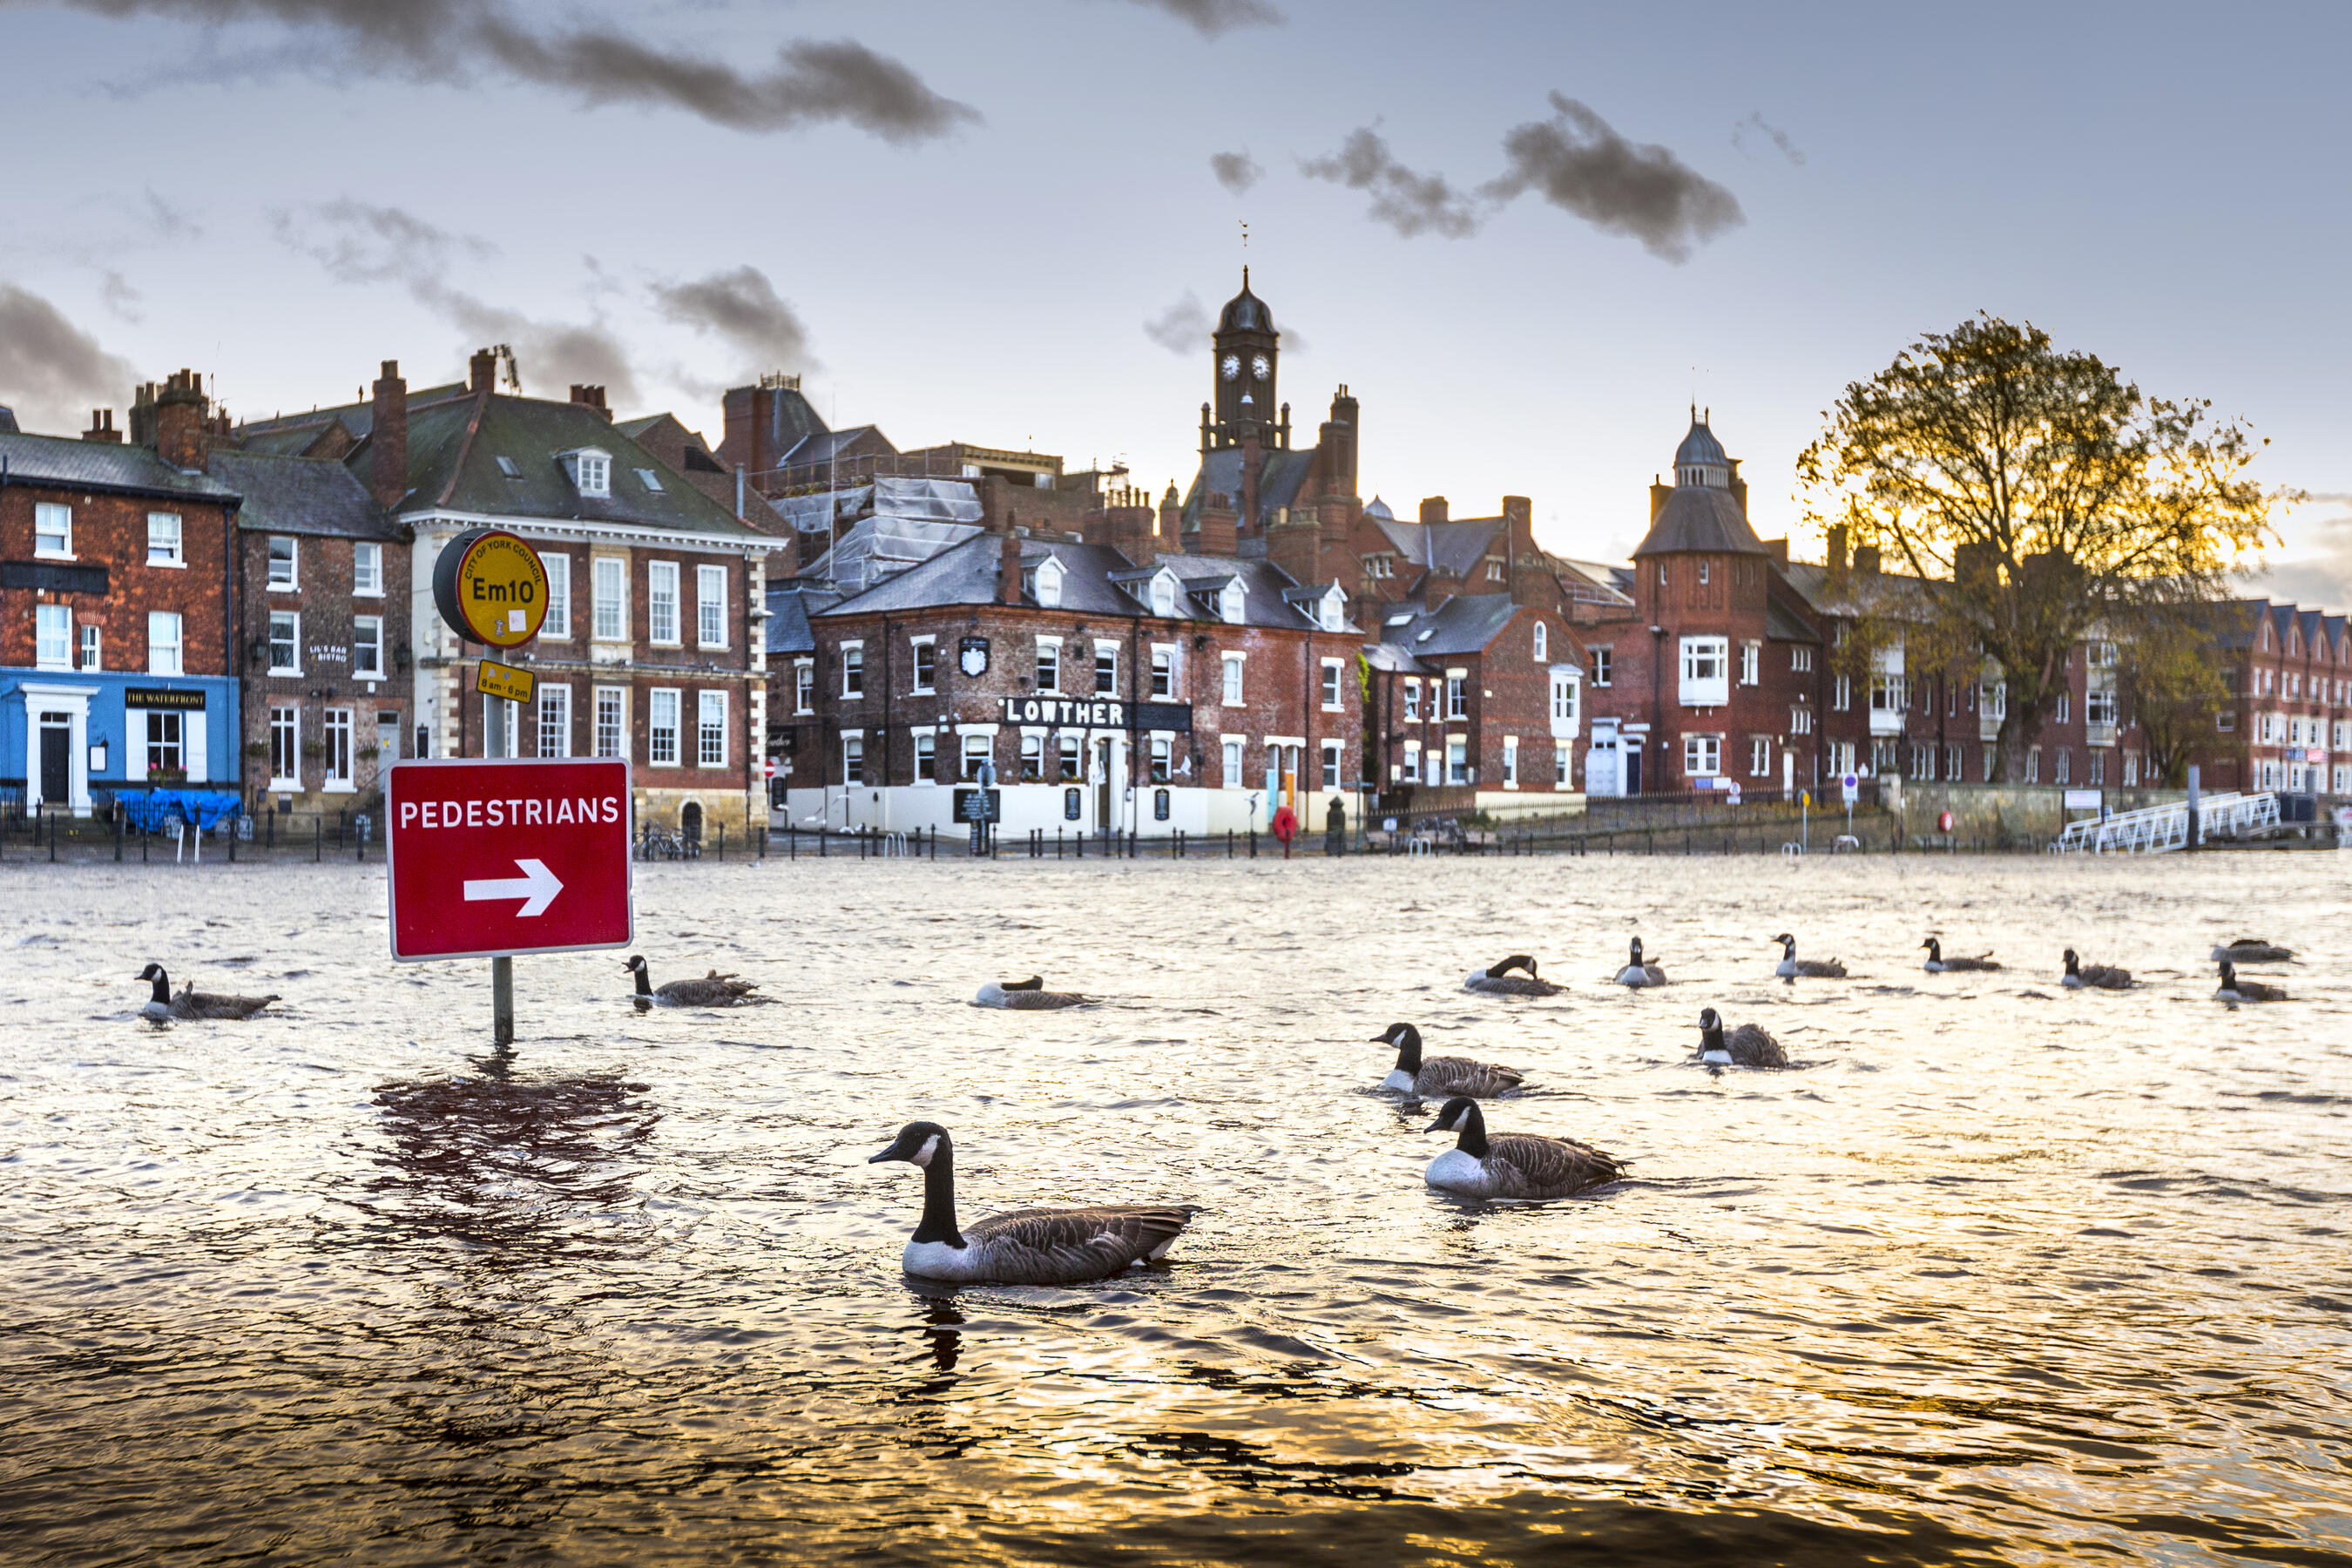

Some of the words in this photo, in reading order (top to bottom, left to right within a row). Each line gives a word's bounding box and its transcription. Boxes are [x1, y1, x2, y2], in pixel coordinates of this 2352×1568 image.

[464, 557, 477, 580] CITY
[476, 545, 488, 558] OF
[488, 539, 511, 551] YORK
[512, 544, 542, 585] COUNCIL
[473, 578, 534, 603] Em10
[127, 693, 144, 703] THE
[146, 693, 203, 705] WATERFRONT
[481, 679, 487, 687] 8
[508, 685, 514, 693] 6
[515, 689, 528, 698] pm
[1007, 699, 1123, 725] LOWTHER
[401, 796, 618, 828] PEDESTRIANS
